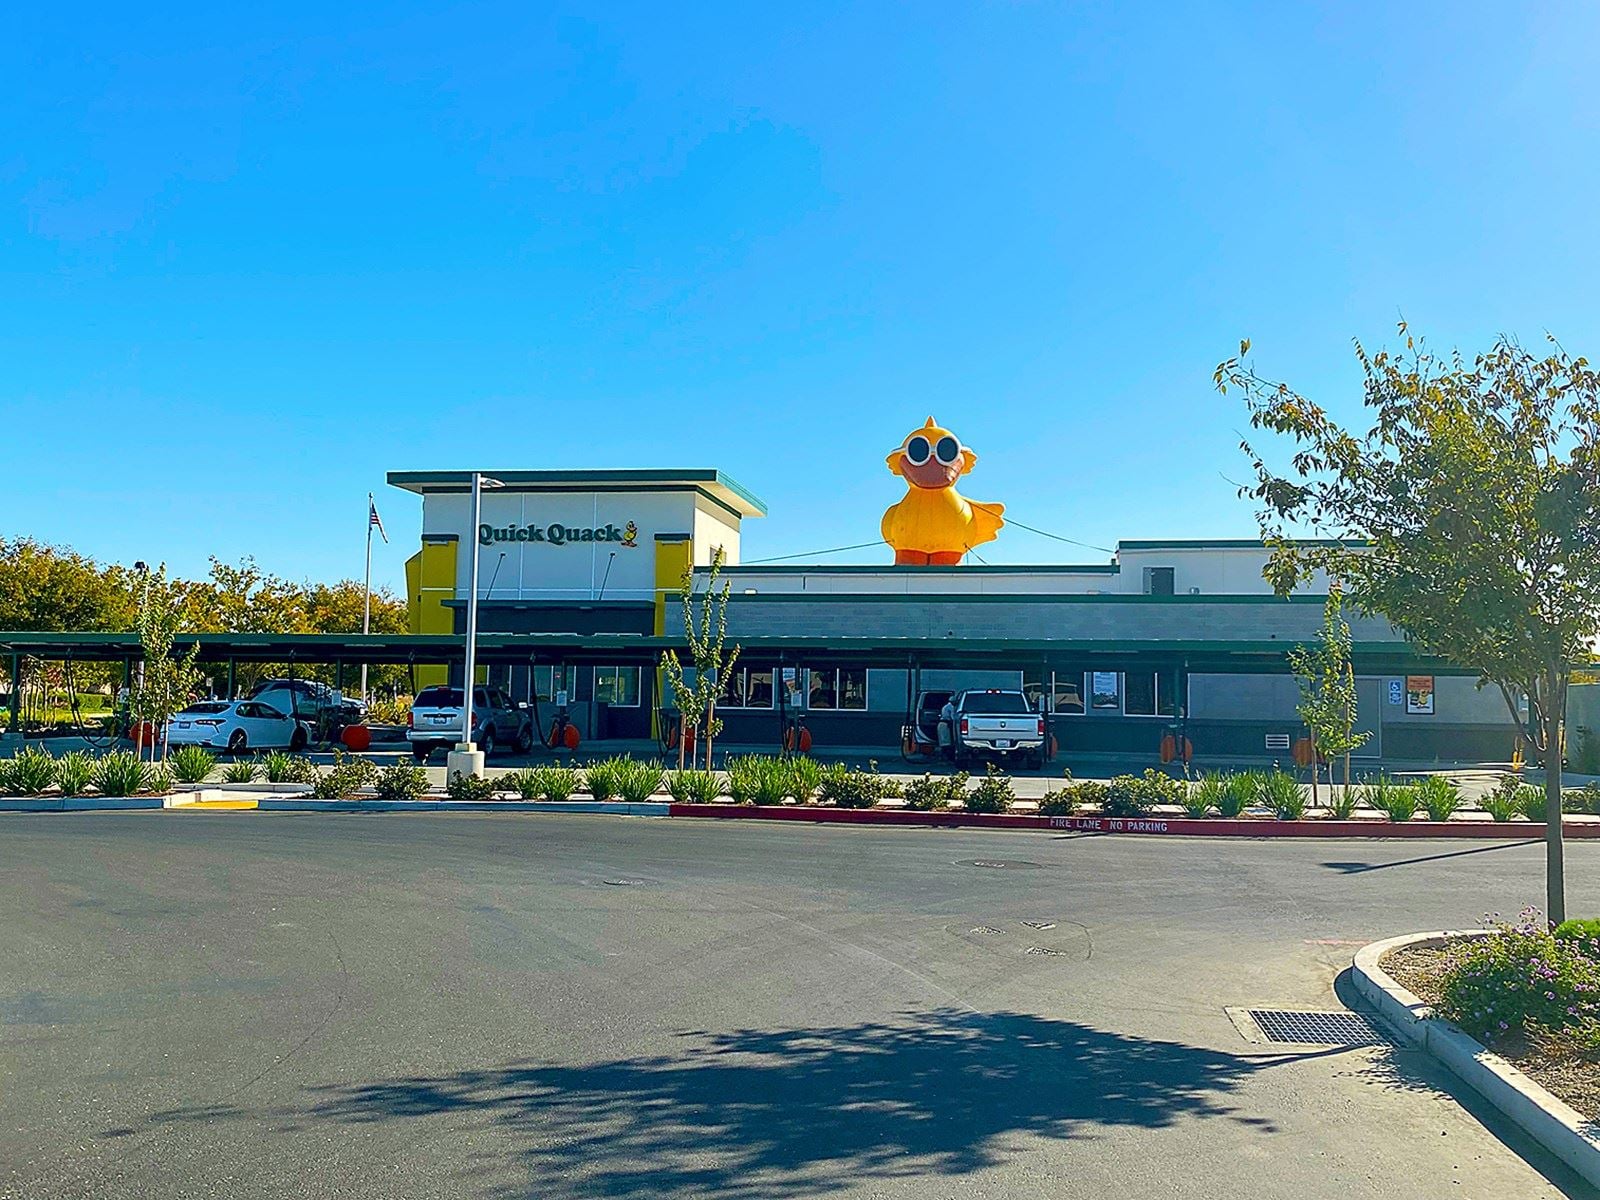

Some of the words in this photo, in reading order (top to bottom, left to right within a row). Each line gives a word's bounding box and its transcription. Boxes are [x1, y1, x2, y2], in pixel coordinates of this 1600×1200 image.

[479, 523, 544, 546] Quick
[547, 523, 622, 546] Quack
[1050, 818, 1071, 828] FIRE
[1076, 820, 1101, 830] LANE
[1109, 821, 1123, 830] NO
[1127, 821, 1168, 832] PARKING
